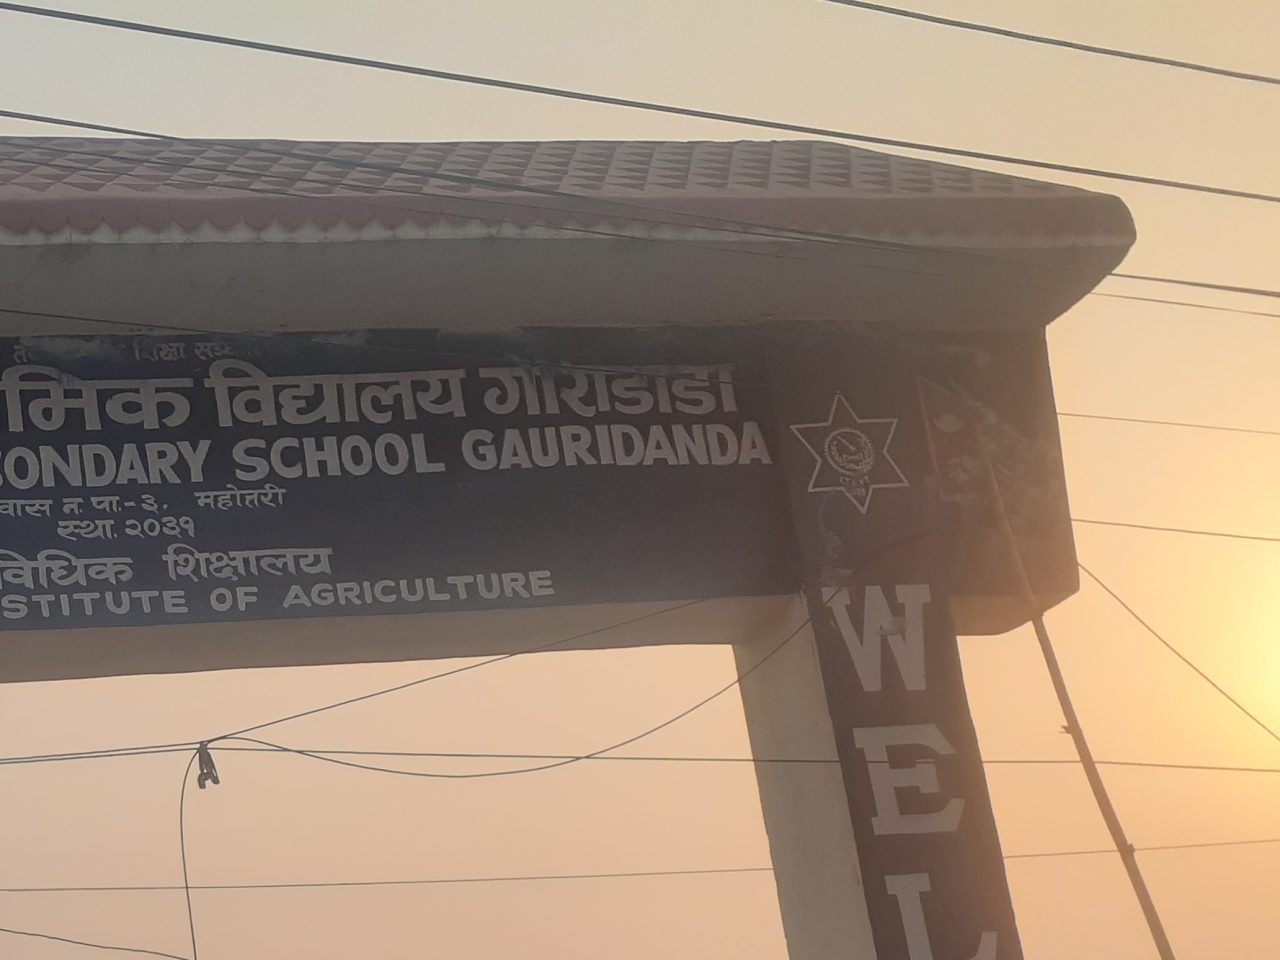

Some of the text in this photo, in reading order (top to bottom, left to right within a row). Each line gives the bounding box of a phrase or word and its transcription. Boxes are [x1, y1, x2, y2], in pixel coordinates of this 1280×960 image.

[204, 358, 467, 427] विद्यालय
[232, 432, 446, 480] SCHOOL
[462, 421, 773, 469] GAURIDANDA
[125, 516, 196, 539] २०३१
[161, 543, 333, 583] शिक्षालय
[209, 586, 259, 612] OF
[283, 570, 555, 609] AGRICULTURE
